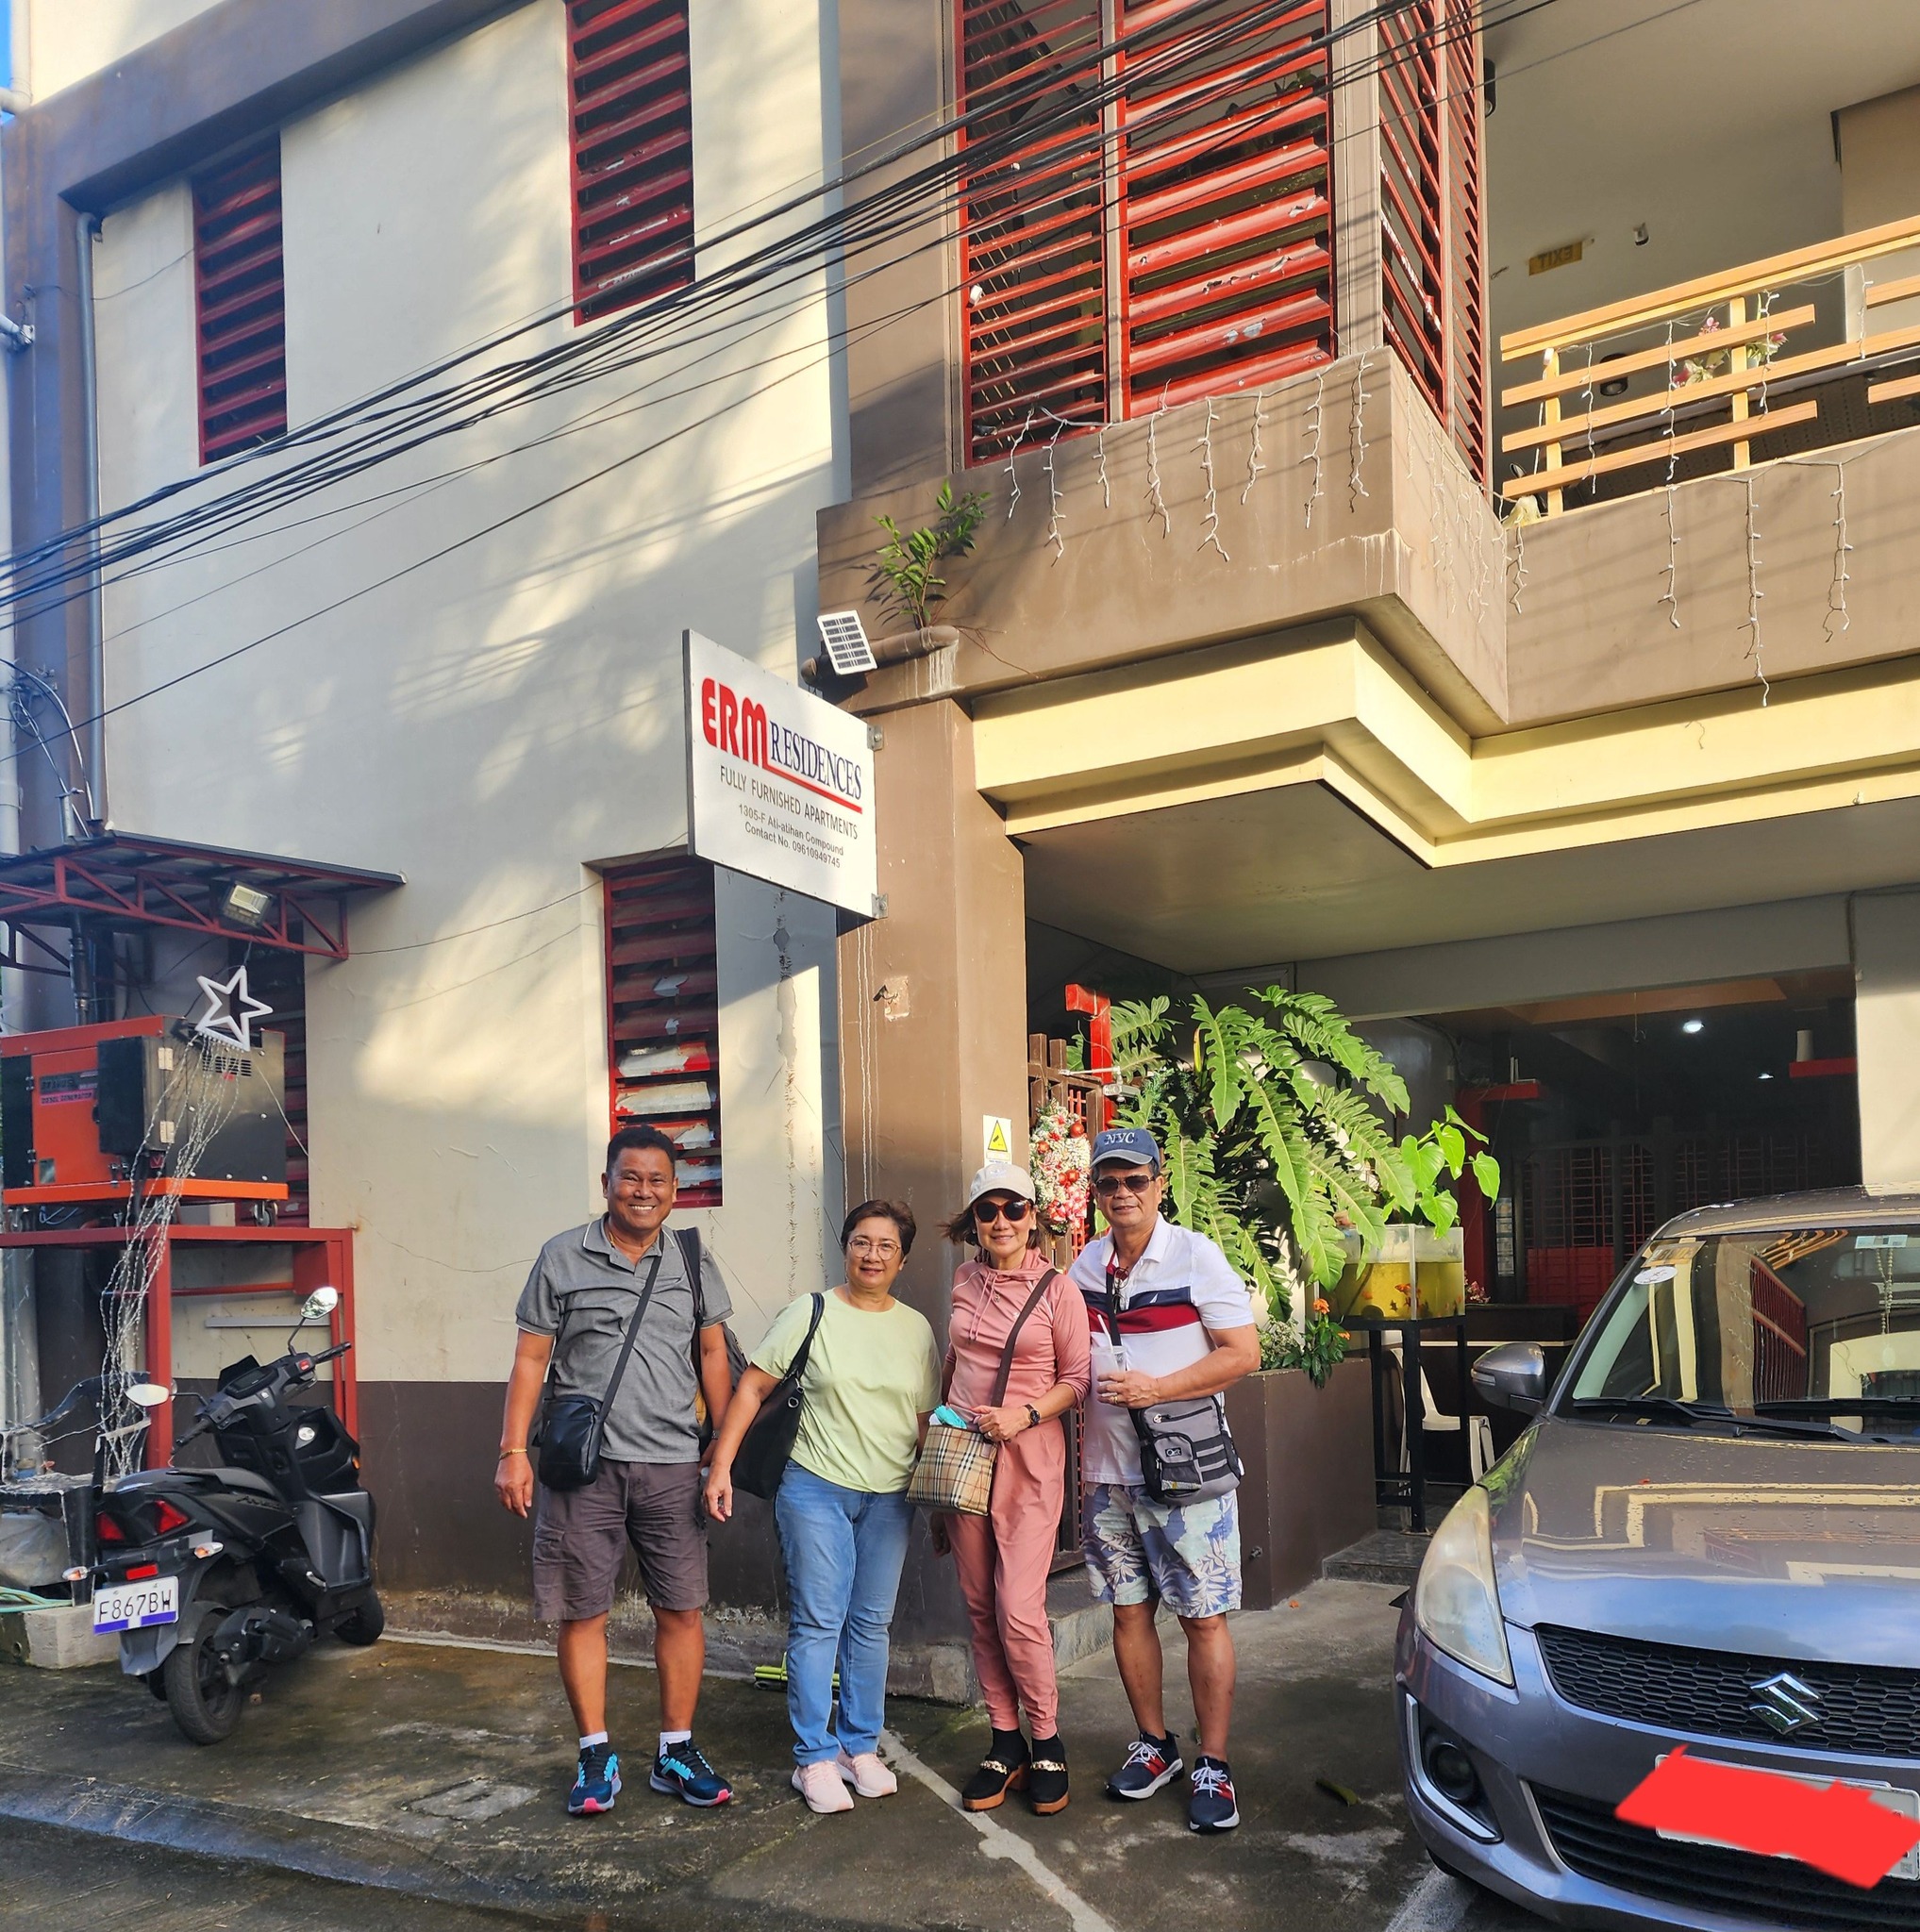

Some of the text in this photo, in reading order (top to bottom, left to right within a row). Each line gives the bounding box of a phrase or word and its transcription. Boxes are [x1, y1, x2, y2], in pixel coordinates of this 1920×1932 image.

[701, 676, 862, 801] ERM RESIDENCES
[720, 764, 859, 840] FULLY FURNISHED APARTMENTS
[738, 803, 844, 857] 1305-F Ati-atihan Compound
[744, 821, 842, 869] Contact No. 09610949745
[1104, 1131, 1136, 1145] NYC
